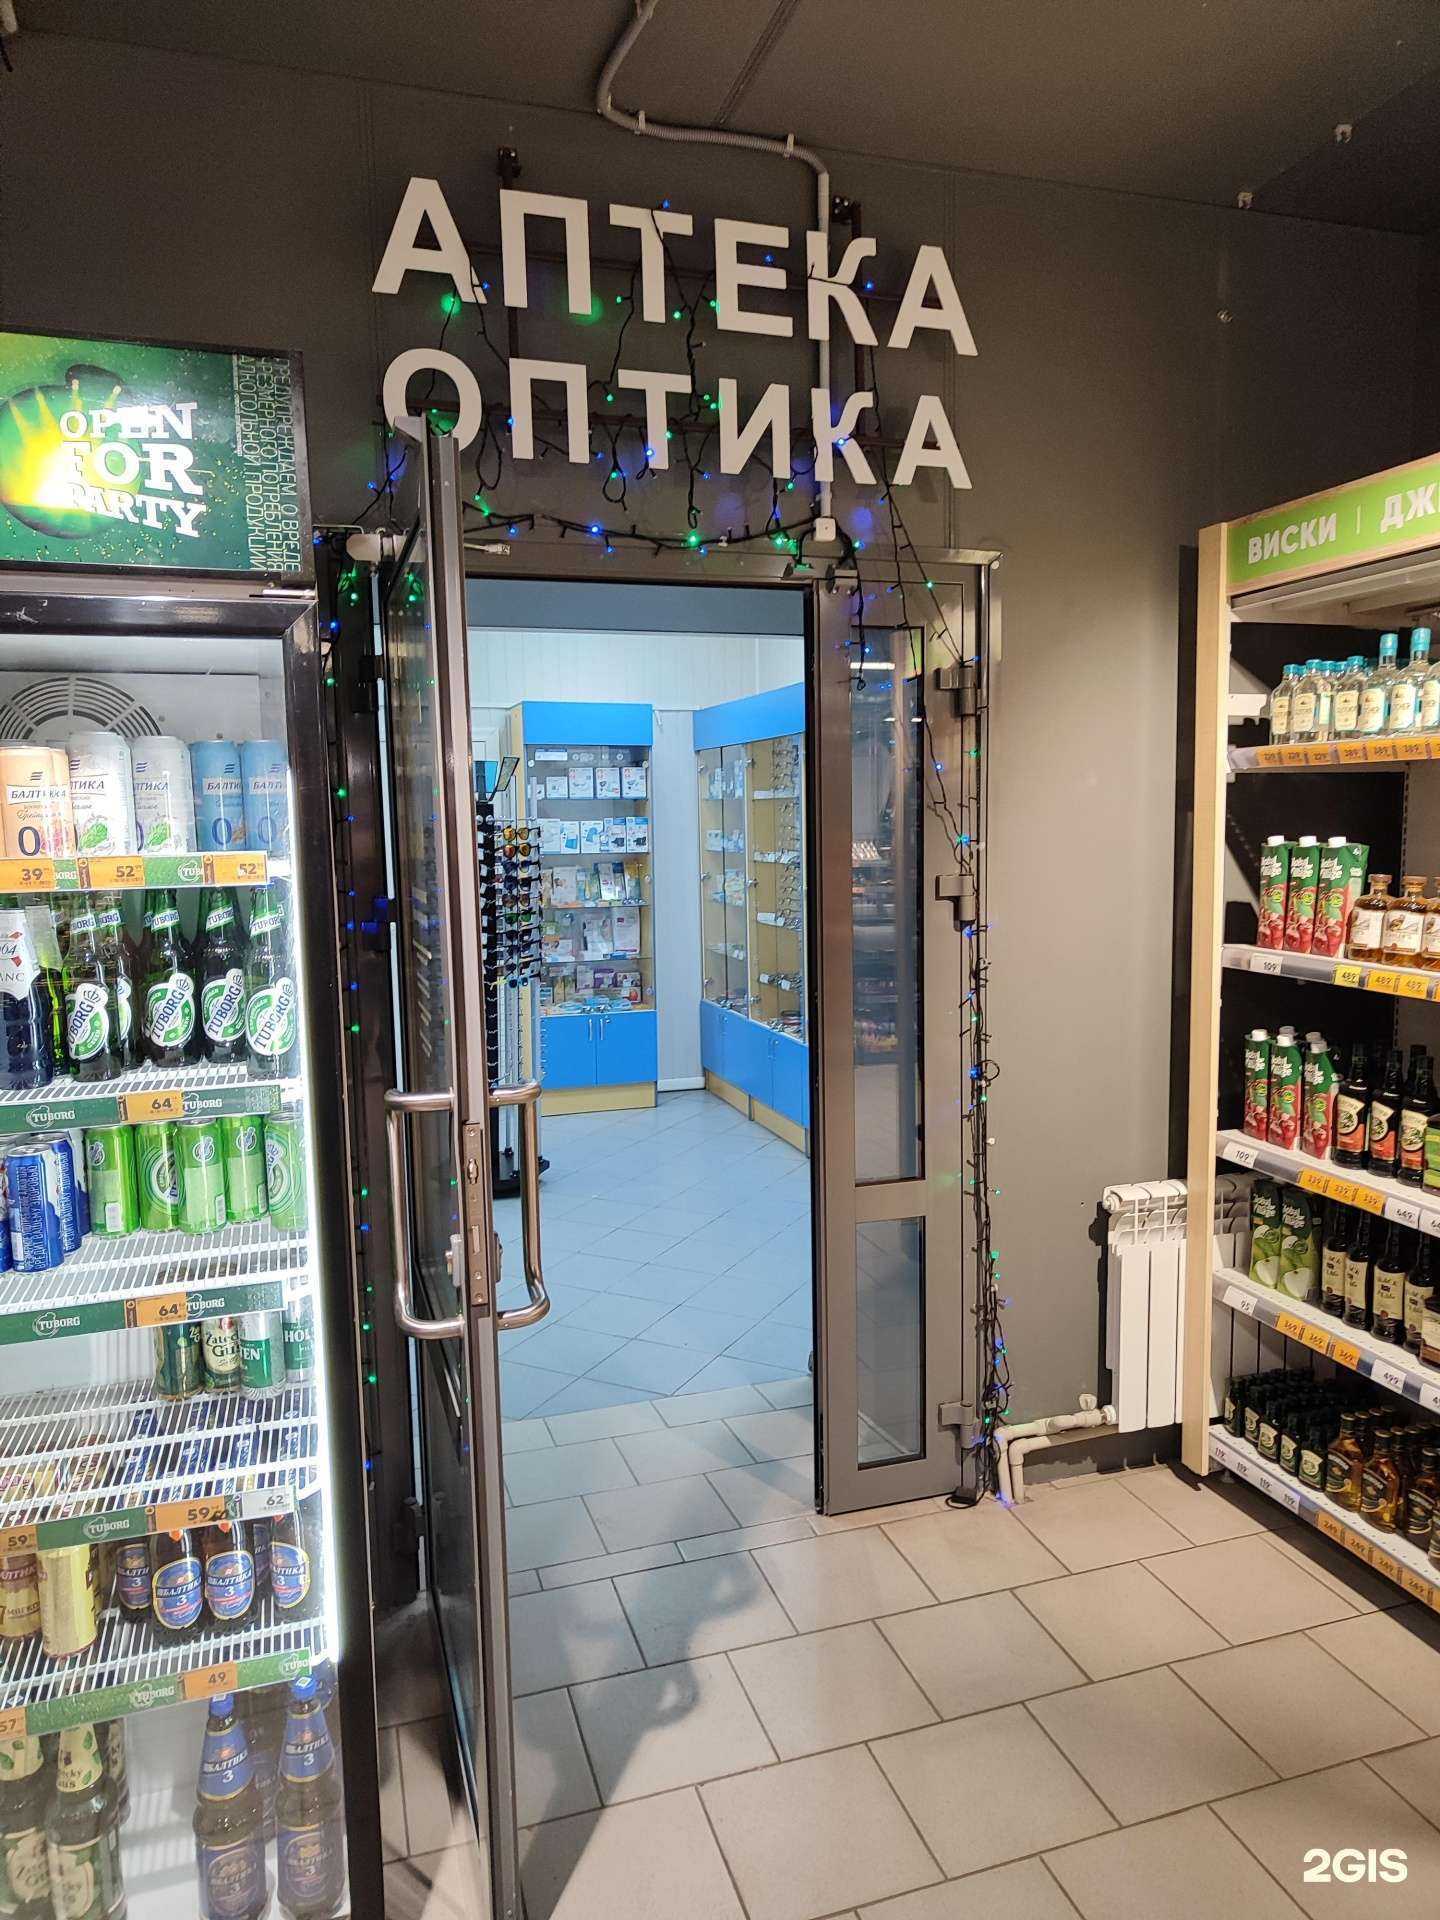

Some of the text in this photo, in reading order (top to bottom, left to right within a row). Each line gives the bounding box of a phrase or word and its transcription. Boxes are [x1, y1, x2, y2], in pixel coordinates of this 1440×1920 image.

[372, 176, 979, 356] АПТЕКА
[59, 402, 198, 440] OPEN
[382, 347, 973, 490] ОПТИКА
[62, 441, 204, 496] FOR
[240, 355, 267, 570] АЛКОГОЛЬНОЙ ПРОДУКЦИИ
[66, 481, 207, 538] PARTY
[261, 462, 284, 572] ПОТРЕБЛЕНИЯ
[1247, 483, 1440, 565] ВИСКИ ДЖ
[281, 519, 301, 571] ВРЕДЕ
[152, 989, 187, 1039] TUBORG
[208, 983, 242, 1036] TUBORG
[151, 1097, 172, 1110] 64
[183, 1098, 223, 1111] TUBORG
[33, 1110, 76, 1123] TUBORG
[159, 1303, 179, 1316] 64
[186, 1299, 225, 1312] TUBORG
[38, 1315, 81, 1331] TUBORG
[267, 1495, 284, 1506] 62
[188, 1507, 209, 1520] 59
[89, 1519, 130, 1533] TUBORG
[8, 1535, 28, 1547] 59
[132, 1577, 142, 1587] 3
[277, 1575, 286, 1586] 3
[225, 1586, 235, 1597] 3
[176, 1594, 188, 1606] 3
[208, 1672, 226, 1684] 49
[303, 1752, 315, 1766] 3
[222, 1770, 235, 1783] 3
